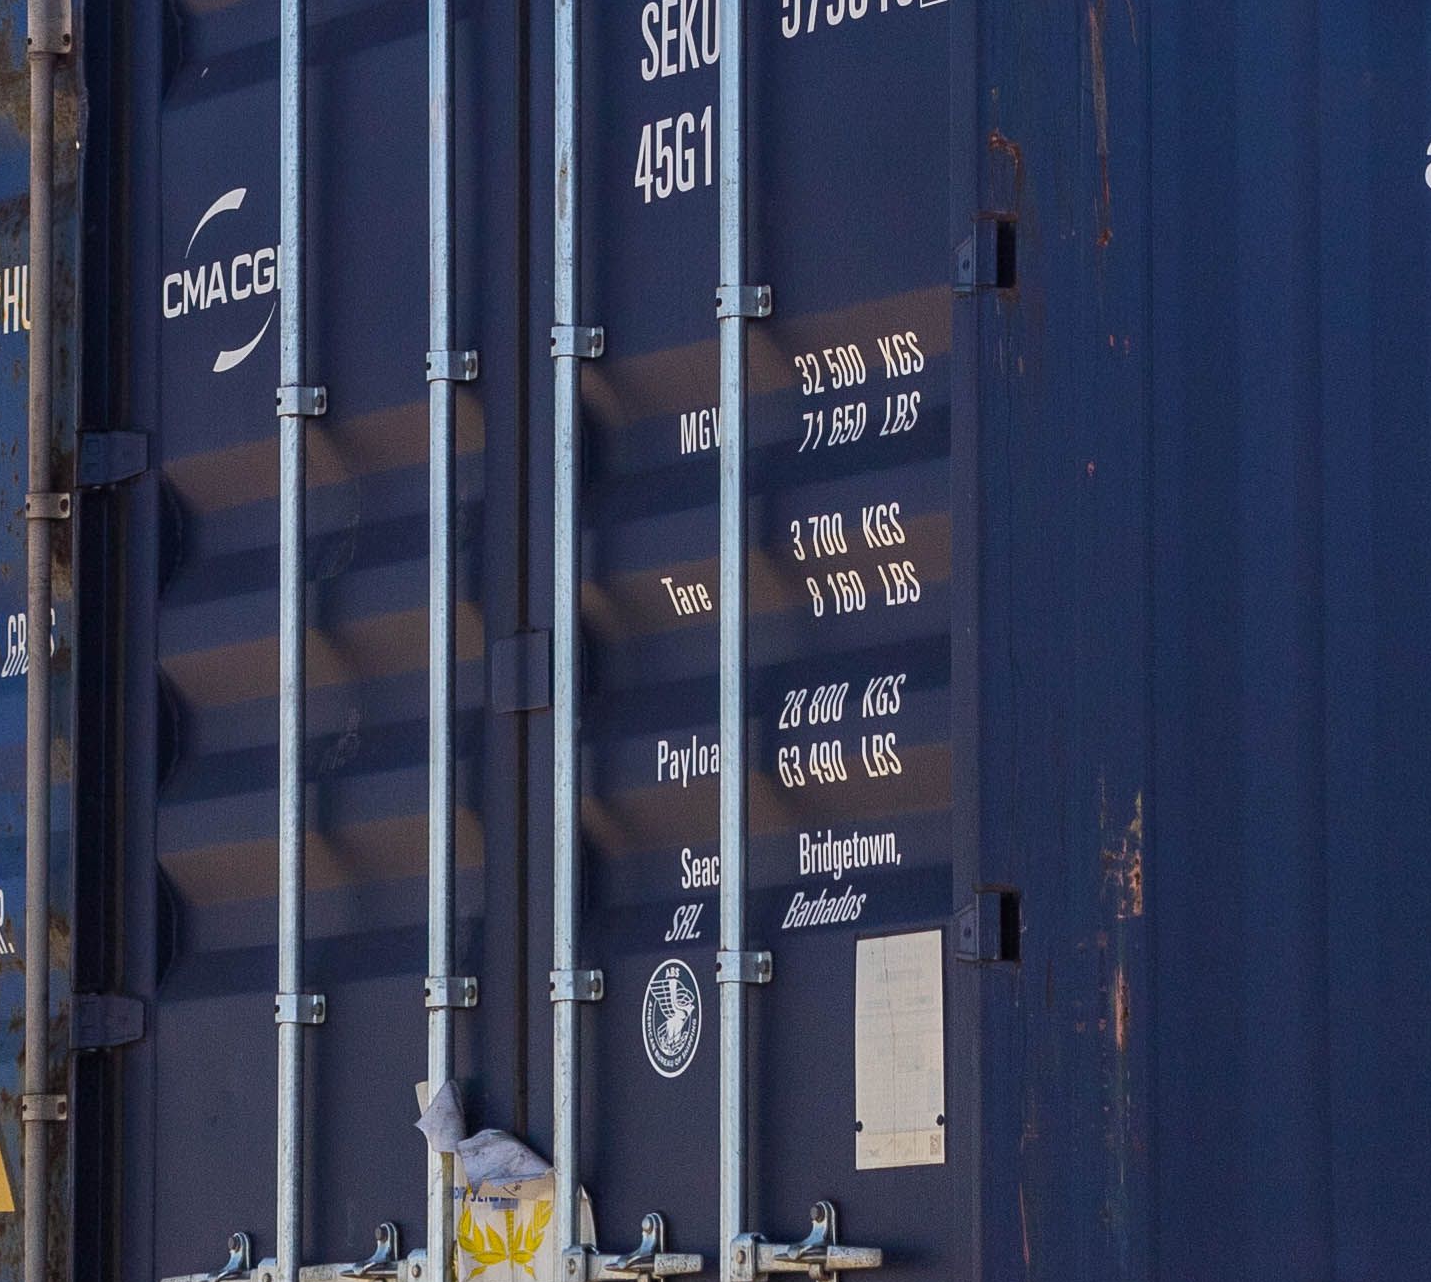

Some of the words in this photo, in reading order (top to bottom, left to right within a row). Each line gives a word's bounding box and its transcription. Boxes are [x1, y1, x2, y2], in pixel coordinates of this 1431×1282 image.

[634, 105, 715, 204] 45G1
[231, 244, 282, 302] CG
[877, 330, 925, 380] KGS
[879, 390, 922, 437] LBS
[861, 502, 907, 549] KGS
[660, 576, 714, 617] Tare
[876, 559, 922, 607] LBS
[861, 673, 907, 719] KGS
[657, 734, 721, 789] Payloa
[861, 731, 903, 779] LBS
[681, 847, 721, 890] Seac
[799, 830, 903, 881] Bridgetown,
[664, 902, 702, 942] SRL.
[781, 885, 867, 930] Barbados
[665, 966, 680, 979] ABS
